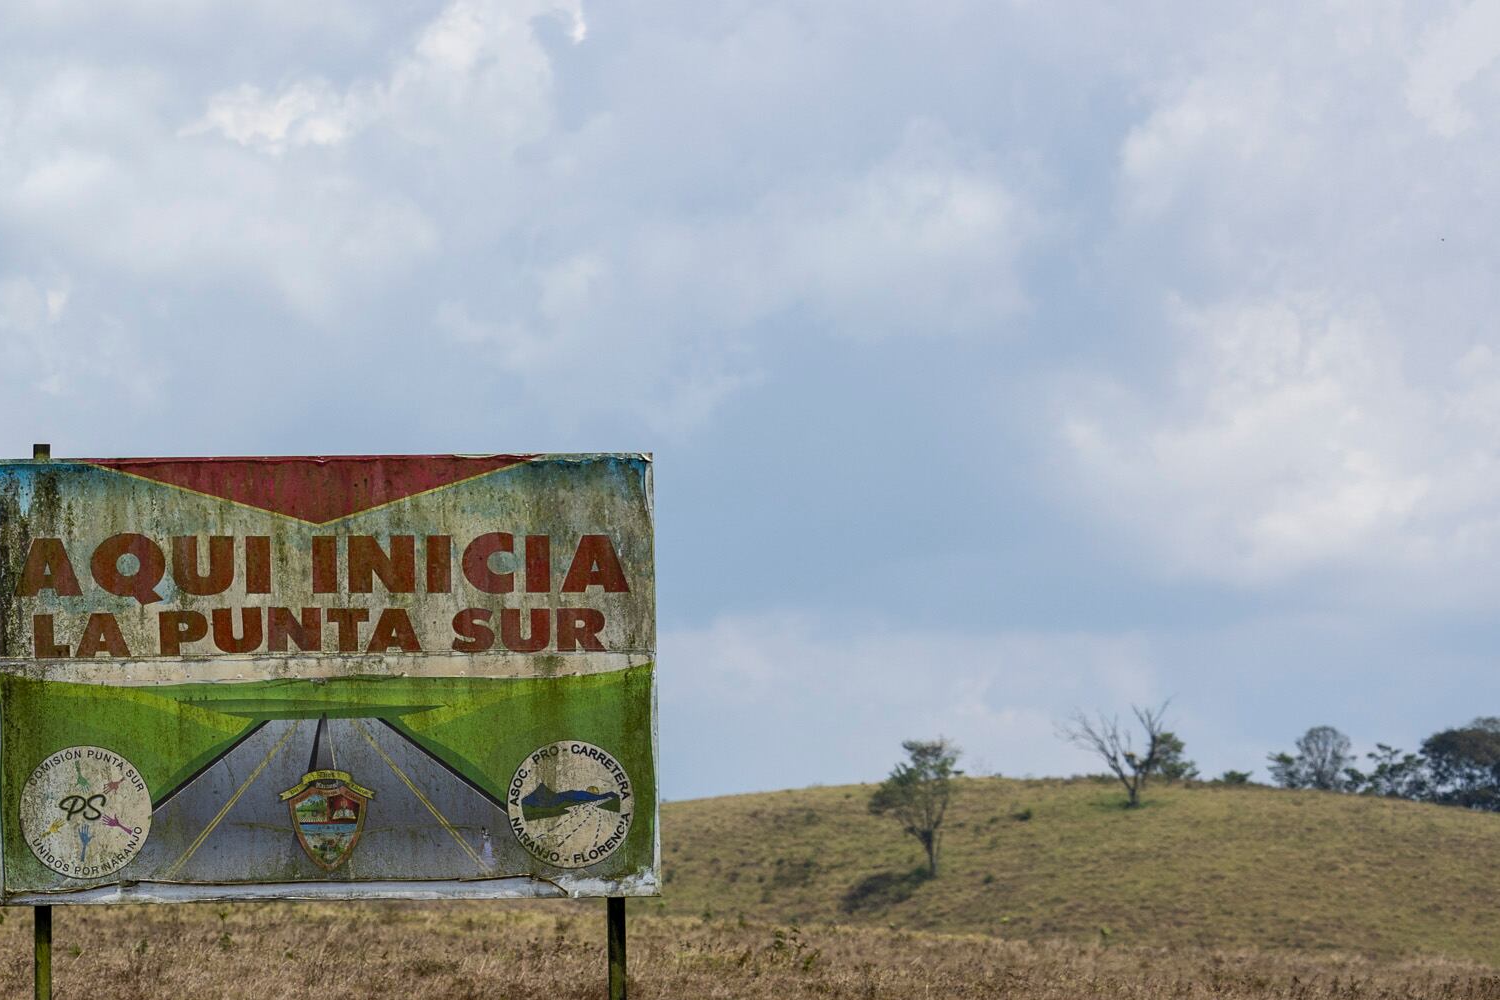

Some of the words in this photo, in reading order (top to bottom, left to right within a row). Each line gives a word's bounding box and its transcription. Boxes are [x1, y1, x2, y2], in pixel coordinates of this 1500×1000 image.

[14, 532, 272, 605] AQUI
[312, 532, 630, 594] INICIA
[33, 612, 131, 658] LA
[159, 607, 423, 657] PUNTA
[452, 607, 607, 653] SUR
[87, 750, 124, 771] PUNTA
[125, 769, 145, 792] SUR
[510, 768, 531, 807] ASOC.
[571, 744, 630, 801] CARRETERA
[59, 793, 107, 822] PS
[32, 837, 70, 872] UNIDOS
[74, 865, 99, 875] POR
[102, 826, 143, 872] NARANJO
[511, 816, 560, 863] NARANJO
[573, 812, 631, 864] FLORENCIA
